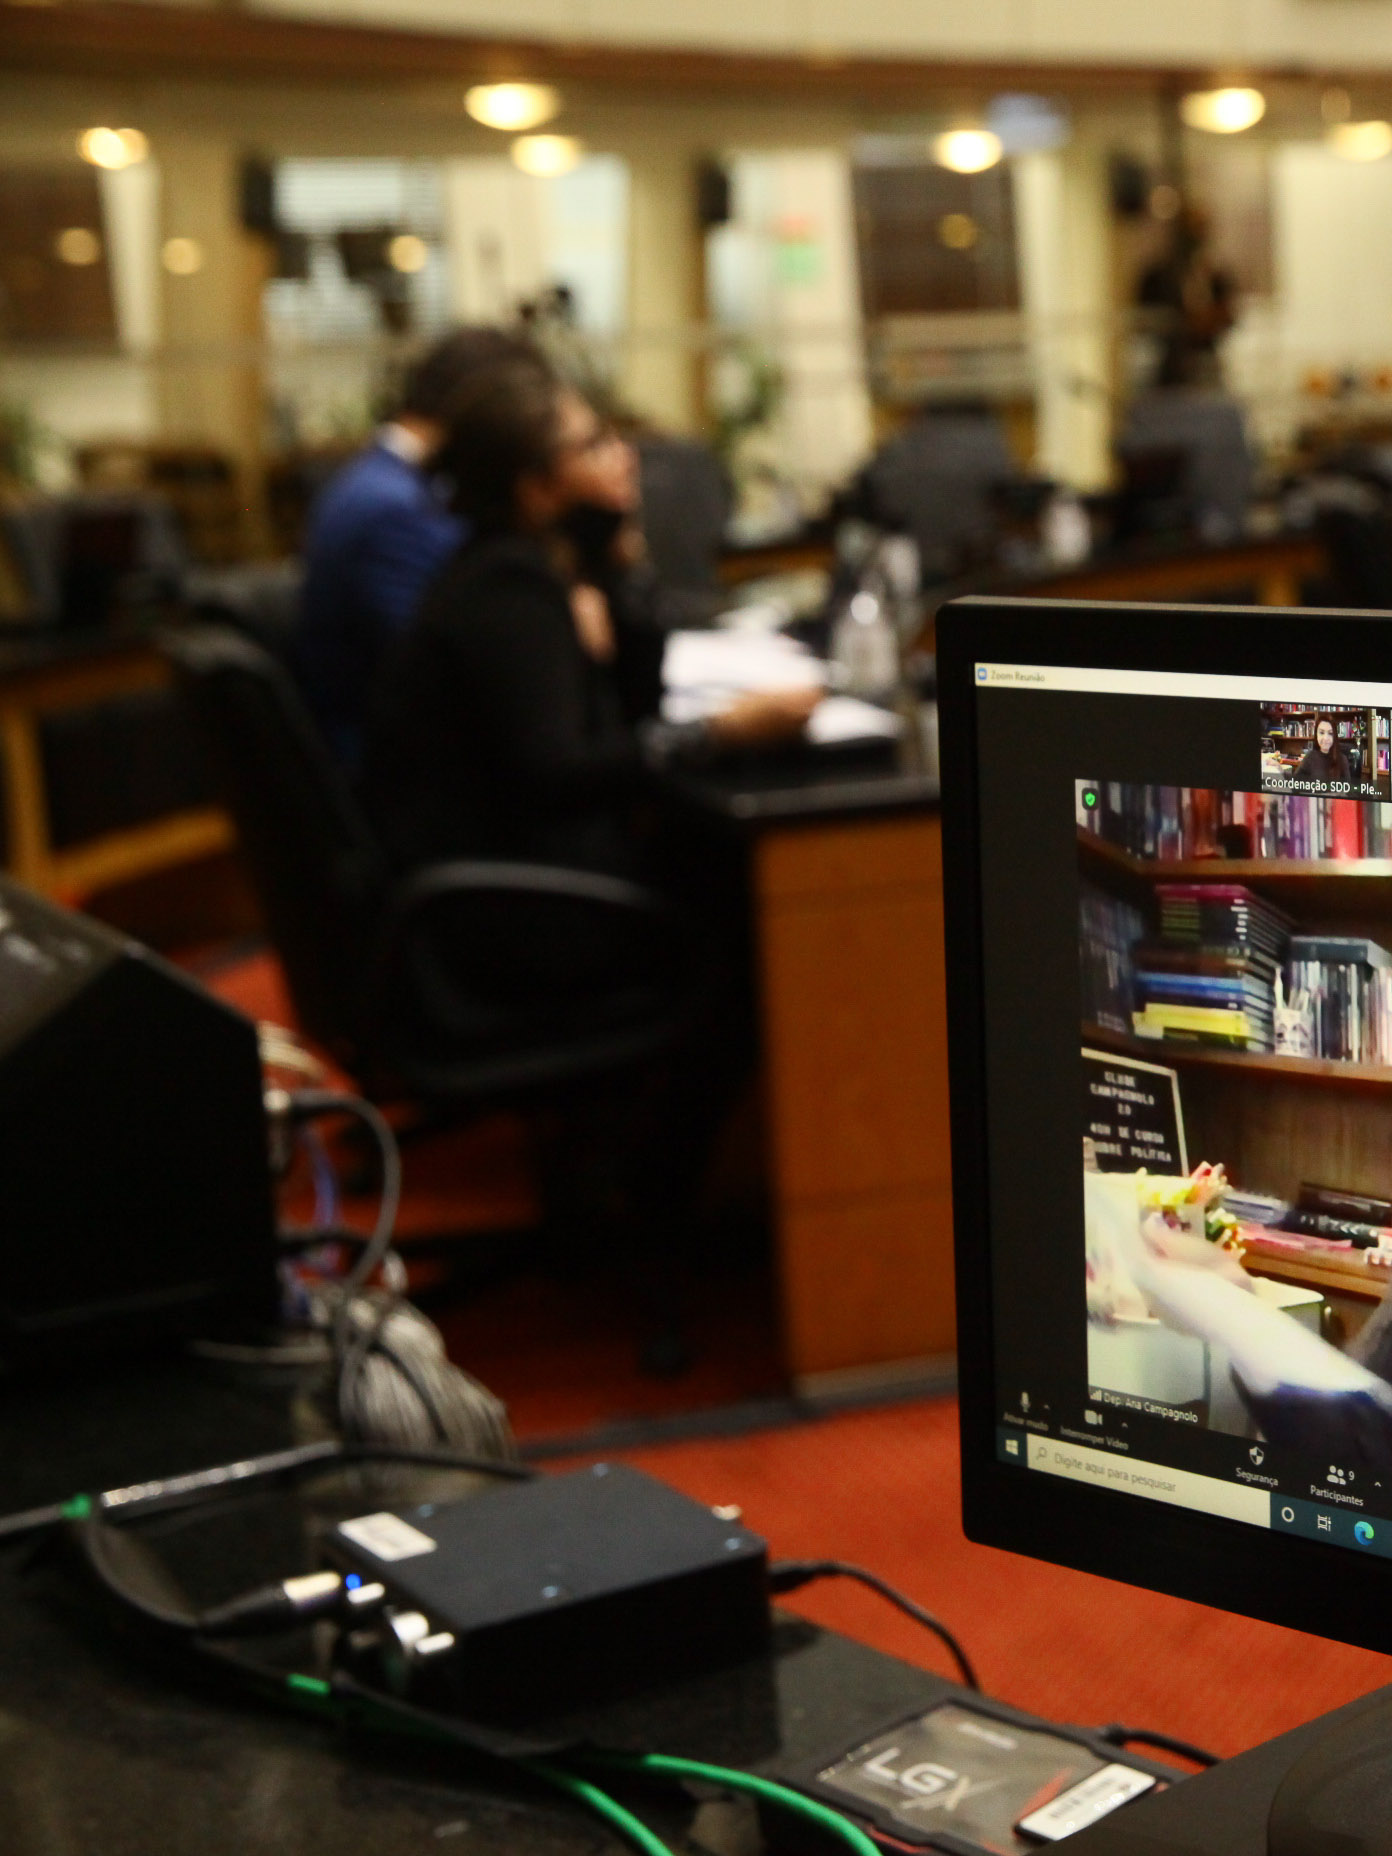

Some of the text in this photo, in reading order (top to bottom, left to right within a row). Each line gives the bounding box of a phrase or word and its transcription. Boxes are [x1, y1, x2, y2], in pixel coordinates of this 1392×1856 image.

[991, 670, 1014, 681] Zoom
[1265, 777, 1327, 793] Coordenação
[1330, 781, 1351, 792] SDD
[1104, 1392, 1198, 1423] Dep. Ana Campagnolo
[1054, 1453, 1176, 1492] Digite aqui para pesquisar
[1235, 1467, 1279, 1487] Segurança
[1348, 1470, 1355, 1481] 9
[1310, 1485, 1364, 1508] Participantes
[863, 1747, 958, 1795] LG
